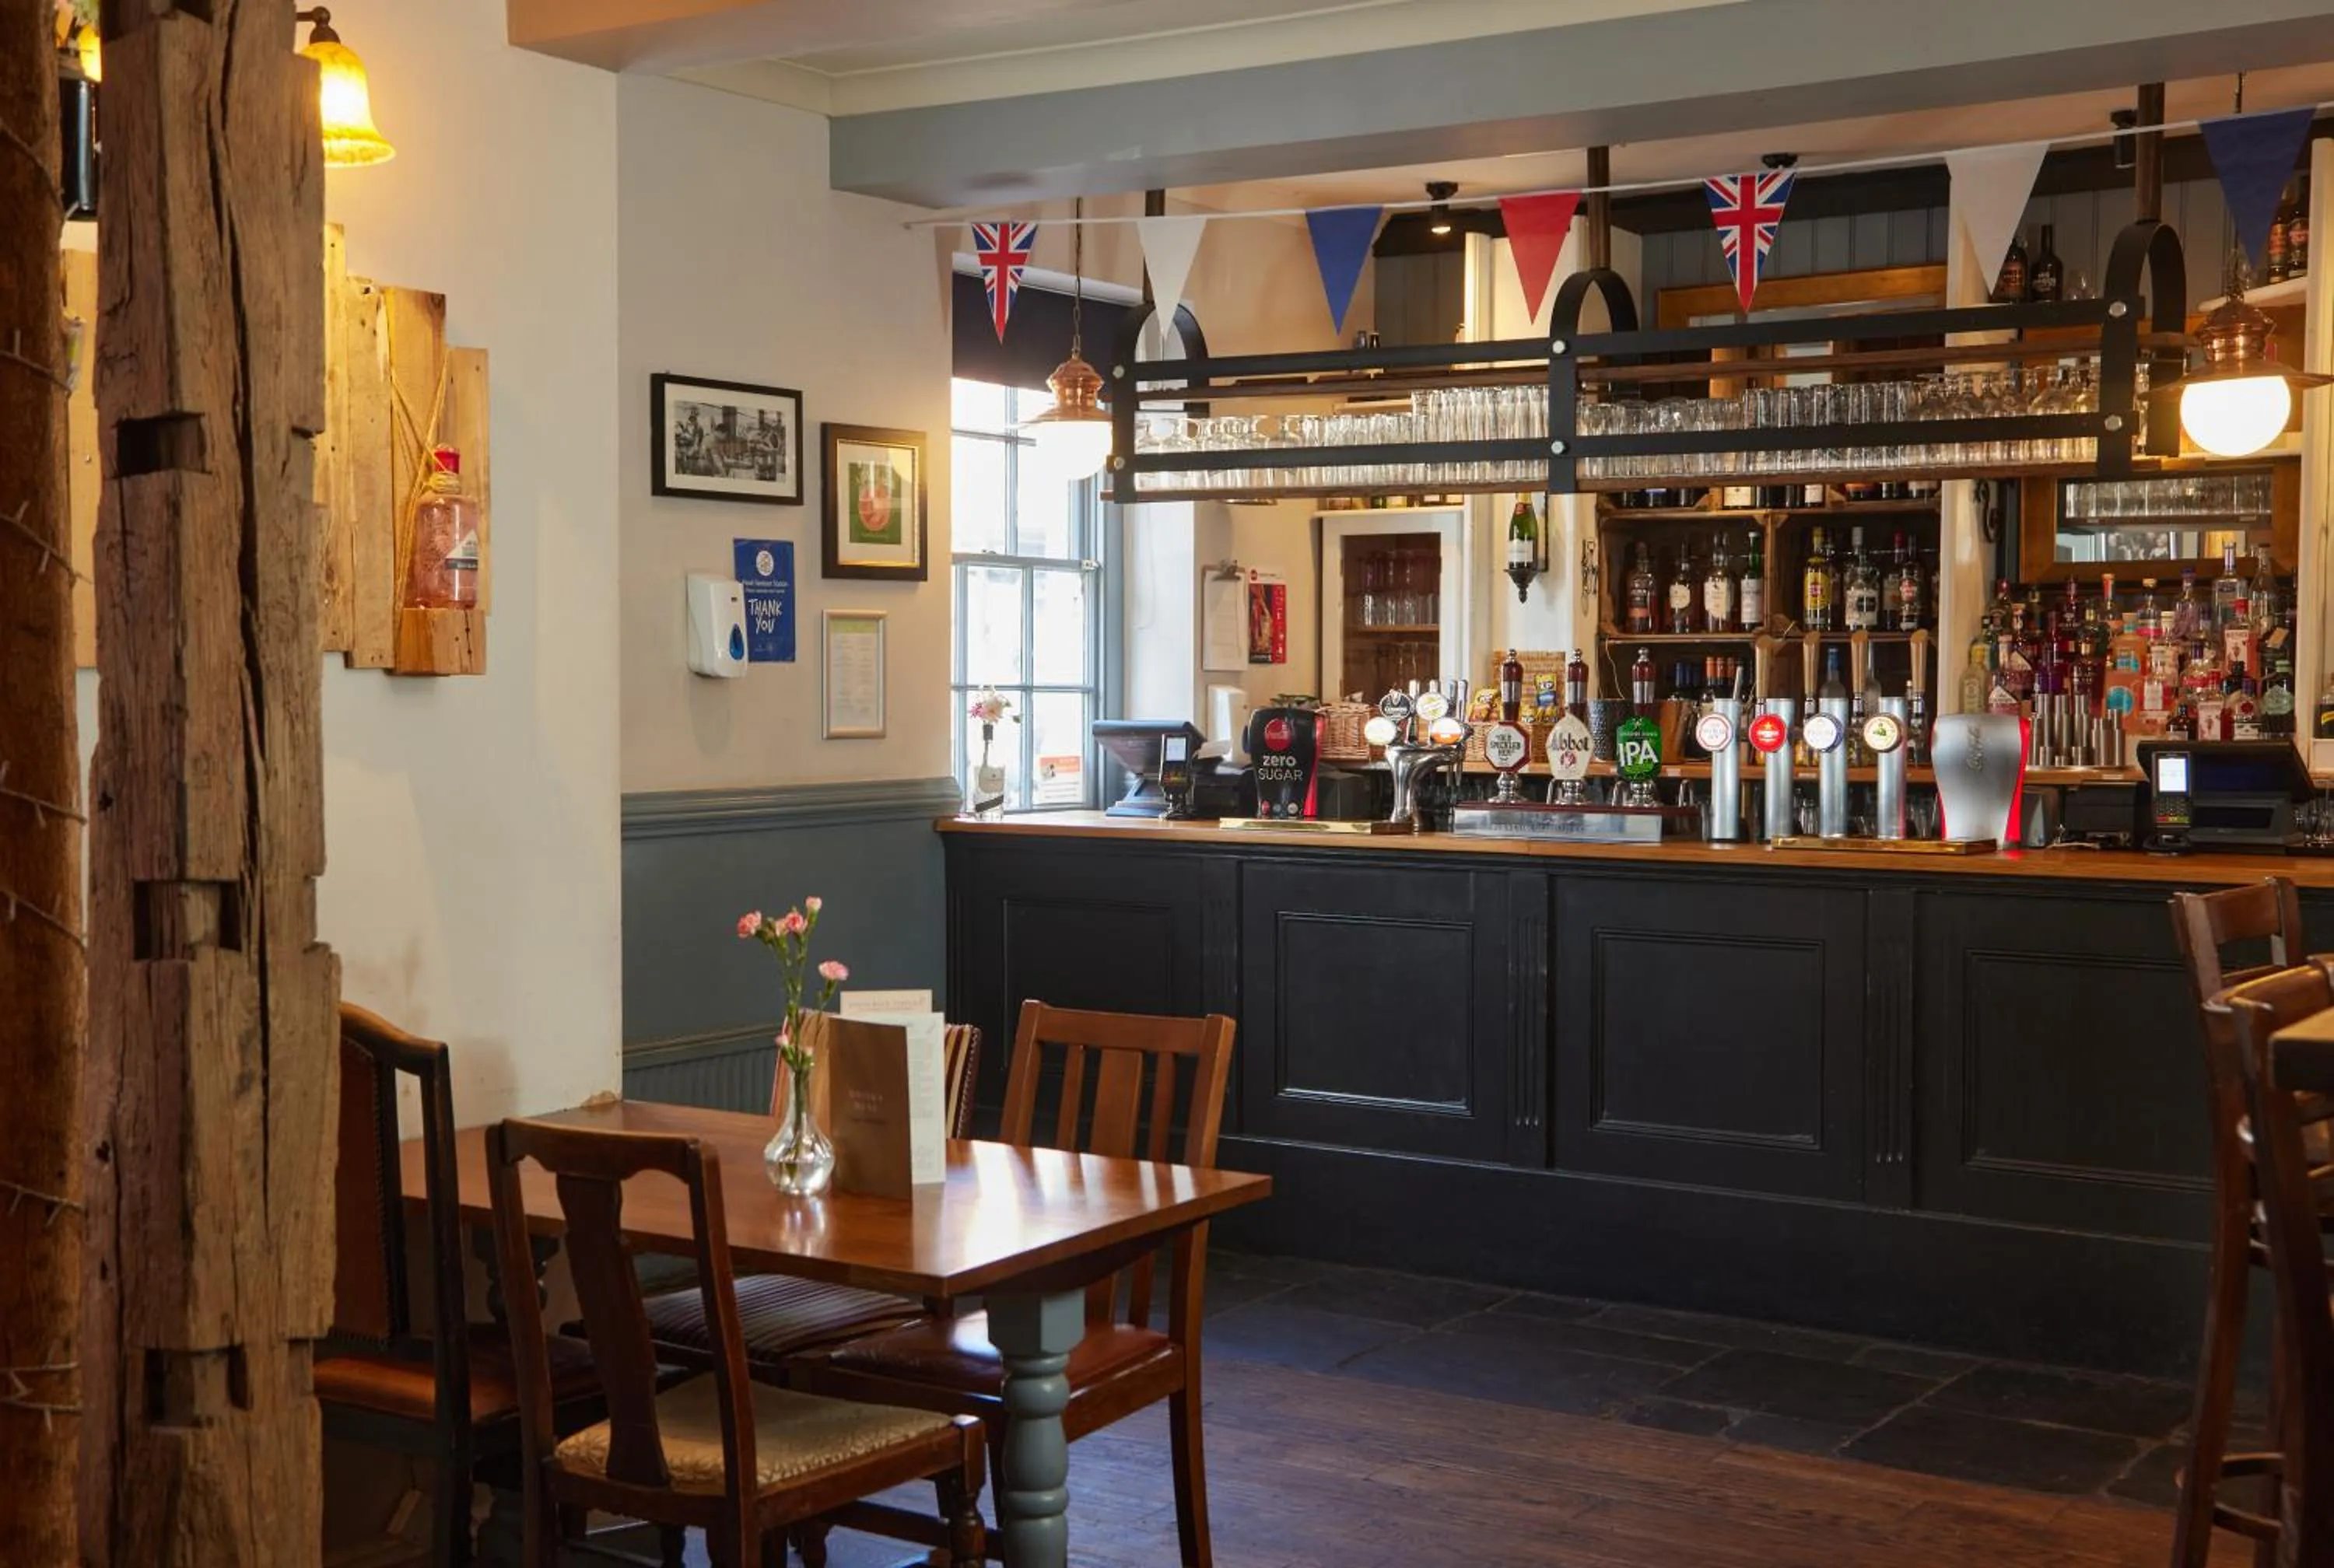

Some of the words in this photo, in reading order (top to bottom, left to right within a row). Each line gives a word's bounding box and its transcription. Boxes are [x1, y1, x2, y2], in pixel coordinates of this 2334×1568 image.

[748, 598, 782, 617] THANK
[756, 616, 776, 634] YOU
[1263, 754, 1297, 767] zero
[1617, 740, 1659, 767] IPA
[1257, 767, 1304, 781] SUGAR
